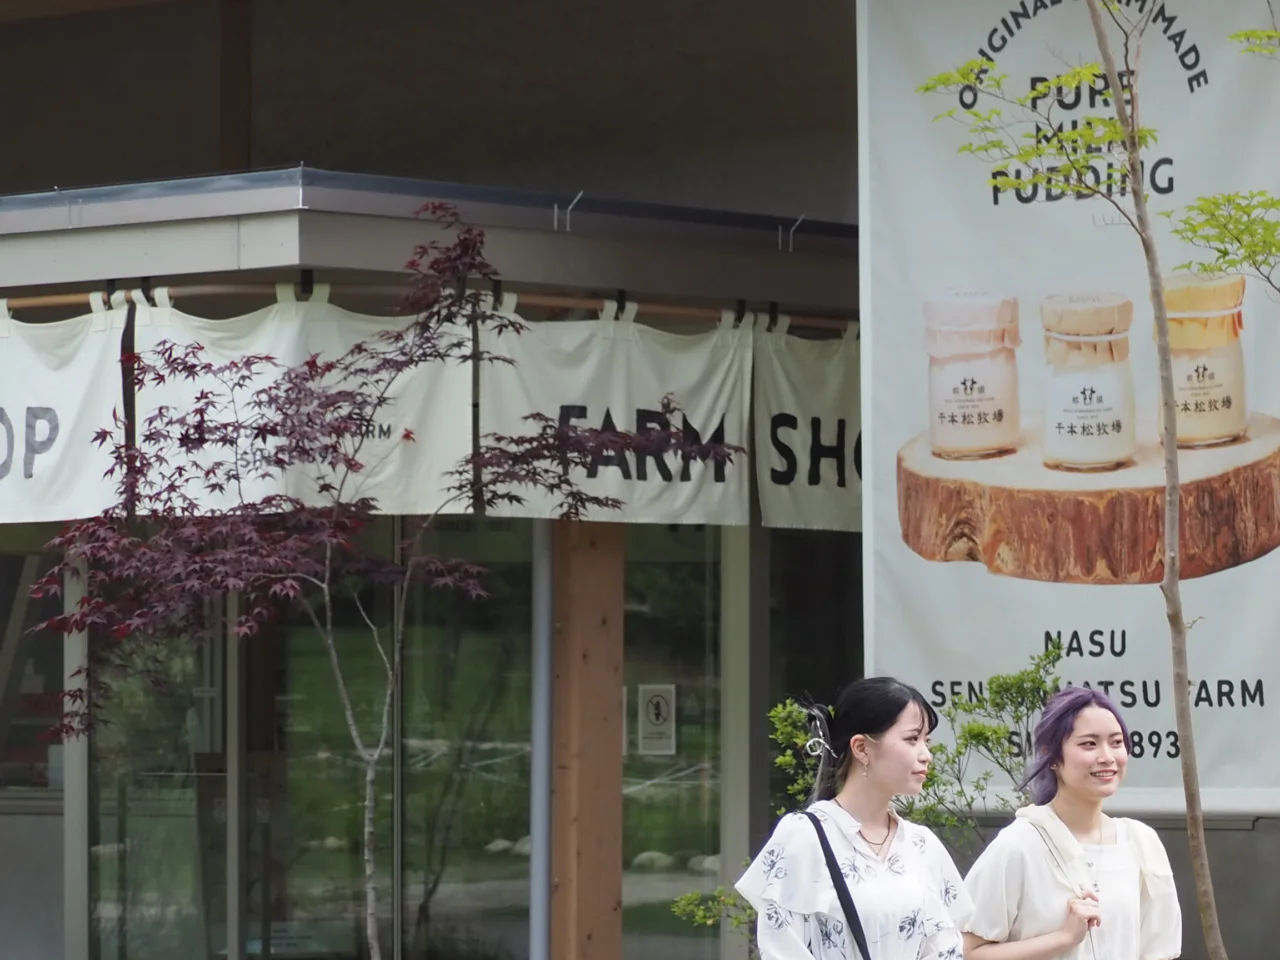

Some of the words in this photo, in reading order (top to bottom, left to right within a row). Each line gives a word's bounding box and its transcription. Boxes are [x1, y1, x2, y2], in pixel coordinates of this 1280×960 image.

[1151, 3, 1209, 94] MADE
[769, 412, 863, 488] SH
[1043, 629, 1127, 658] NASU
[1187, 678, 1265, 708] ARM
